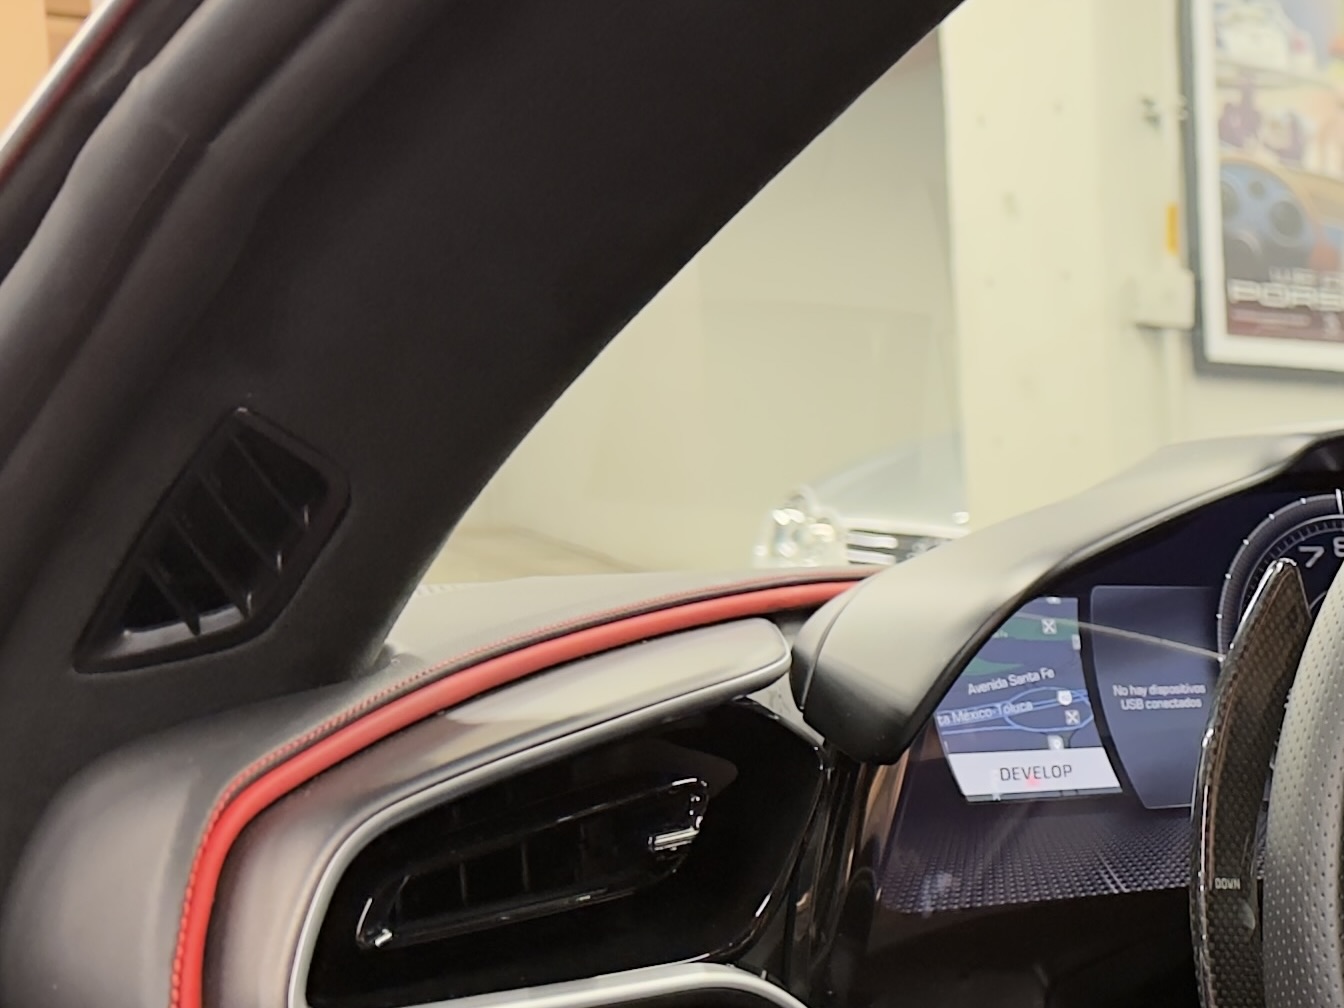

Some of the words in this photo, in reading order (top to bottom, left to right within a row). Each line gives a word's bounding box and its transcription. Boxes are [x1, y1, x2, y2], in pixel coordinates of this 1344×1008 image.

[1298, 545, 1325, 568] 7
[968, 677, 1008, 696] Avenida
[1008, 671, 1041, 687] Santa
[1040, 667, 1055, 680] Fe
[1112, 684, 1128, 697] No
[1129, 684, 1148, 697] hay
[1148, 682, 1206, 696] dispositivos
[1121, 698, 1145, 711] USB
[1000, 764, 1073, 782] DEVELOP
[1215, 877, 1241, 890] DOWN
